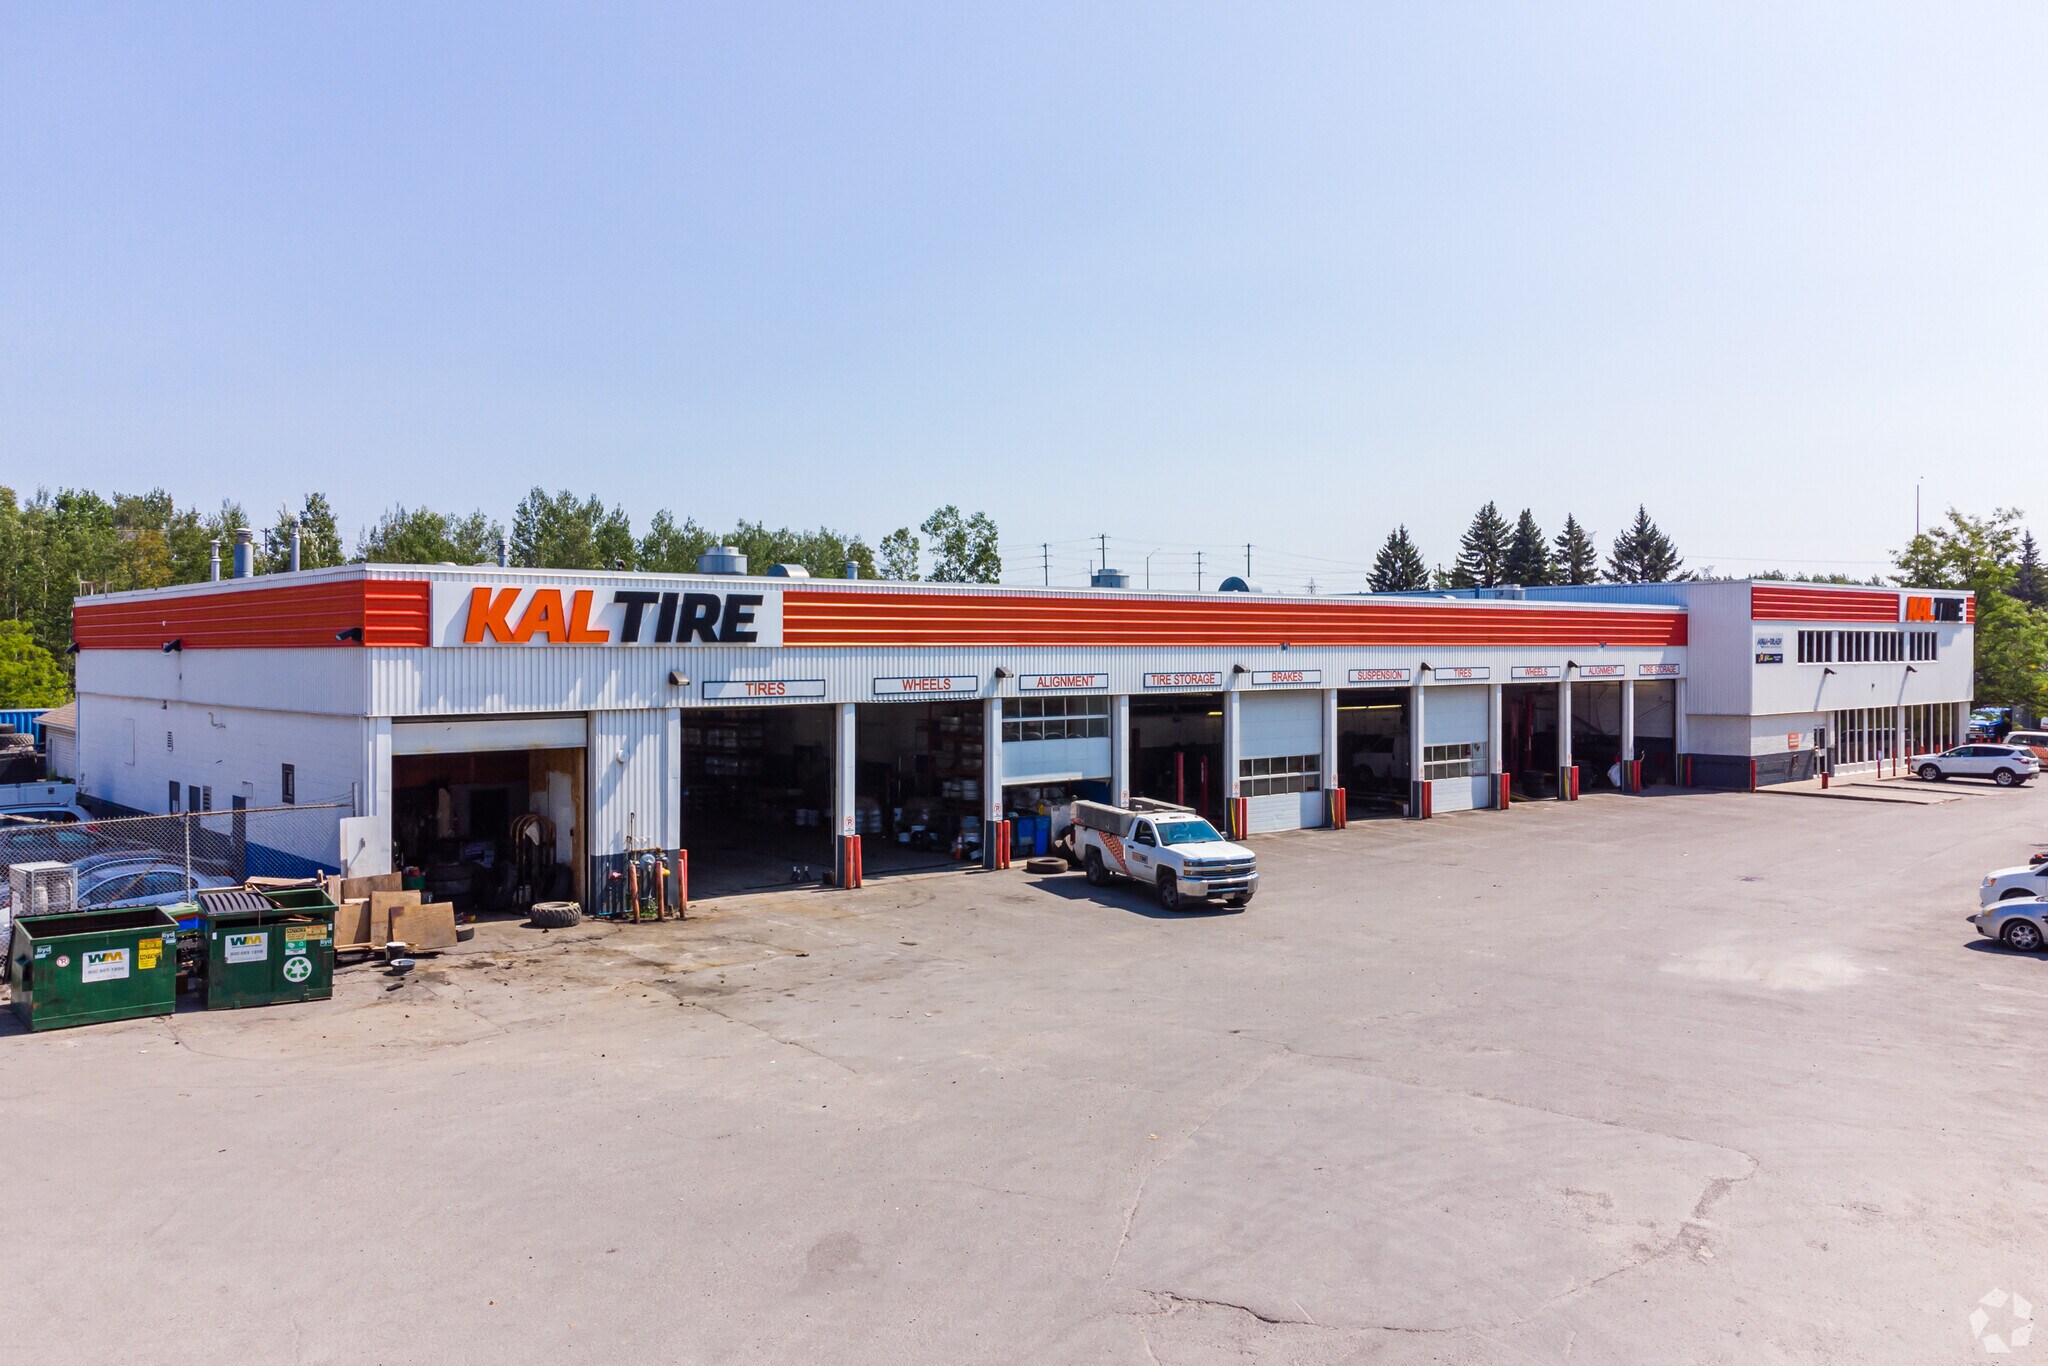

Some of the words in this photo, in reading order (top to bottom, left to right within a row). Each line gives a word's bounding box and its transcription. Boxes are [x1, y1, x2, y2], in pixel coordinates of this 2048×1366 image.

[1905, 597, 1936, 621] KAL
[463, 587, 610, 644] KAL
[613, 590, 764, 643] TIRE
[1271, 671, 1304, 682] BRAKES
[1357, 670, 1402, 681] SUSPENSION
[1453, 668, 1473, 678] TIRES
[1524, 667, 1548, 677] WHEELS
[1588, 666, 1618, 675] ALIGNMENT
[902, 678, 952, 691] WHEELS
[1036, 675, 1096, 688] ALIGNMENT
[1150, 674, 1171, 686] TIRE
[1173, 673, 1216, 685] STORAGE
[745, 682, 786, 696] TIRES
[230, 935, 263, 946] WM
[88, 951, 123, 963] WM
